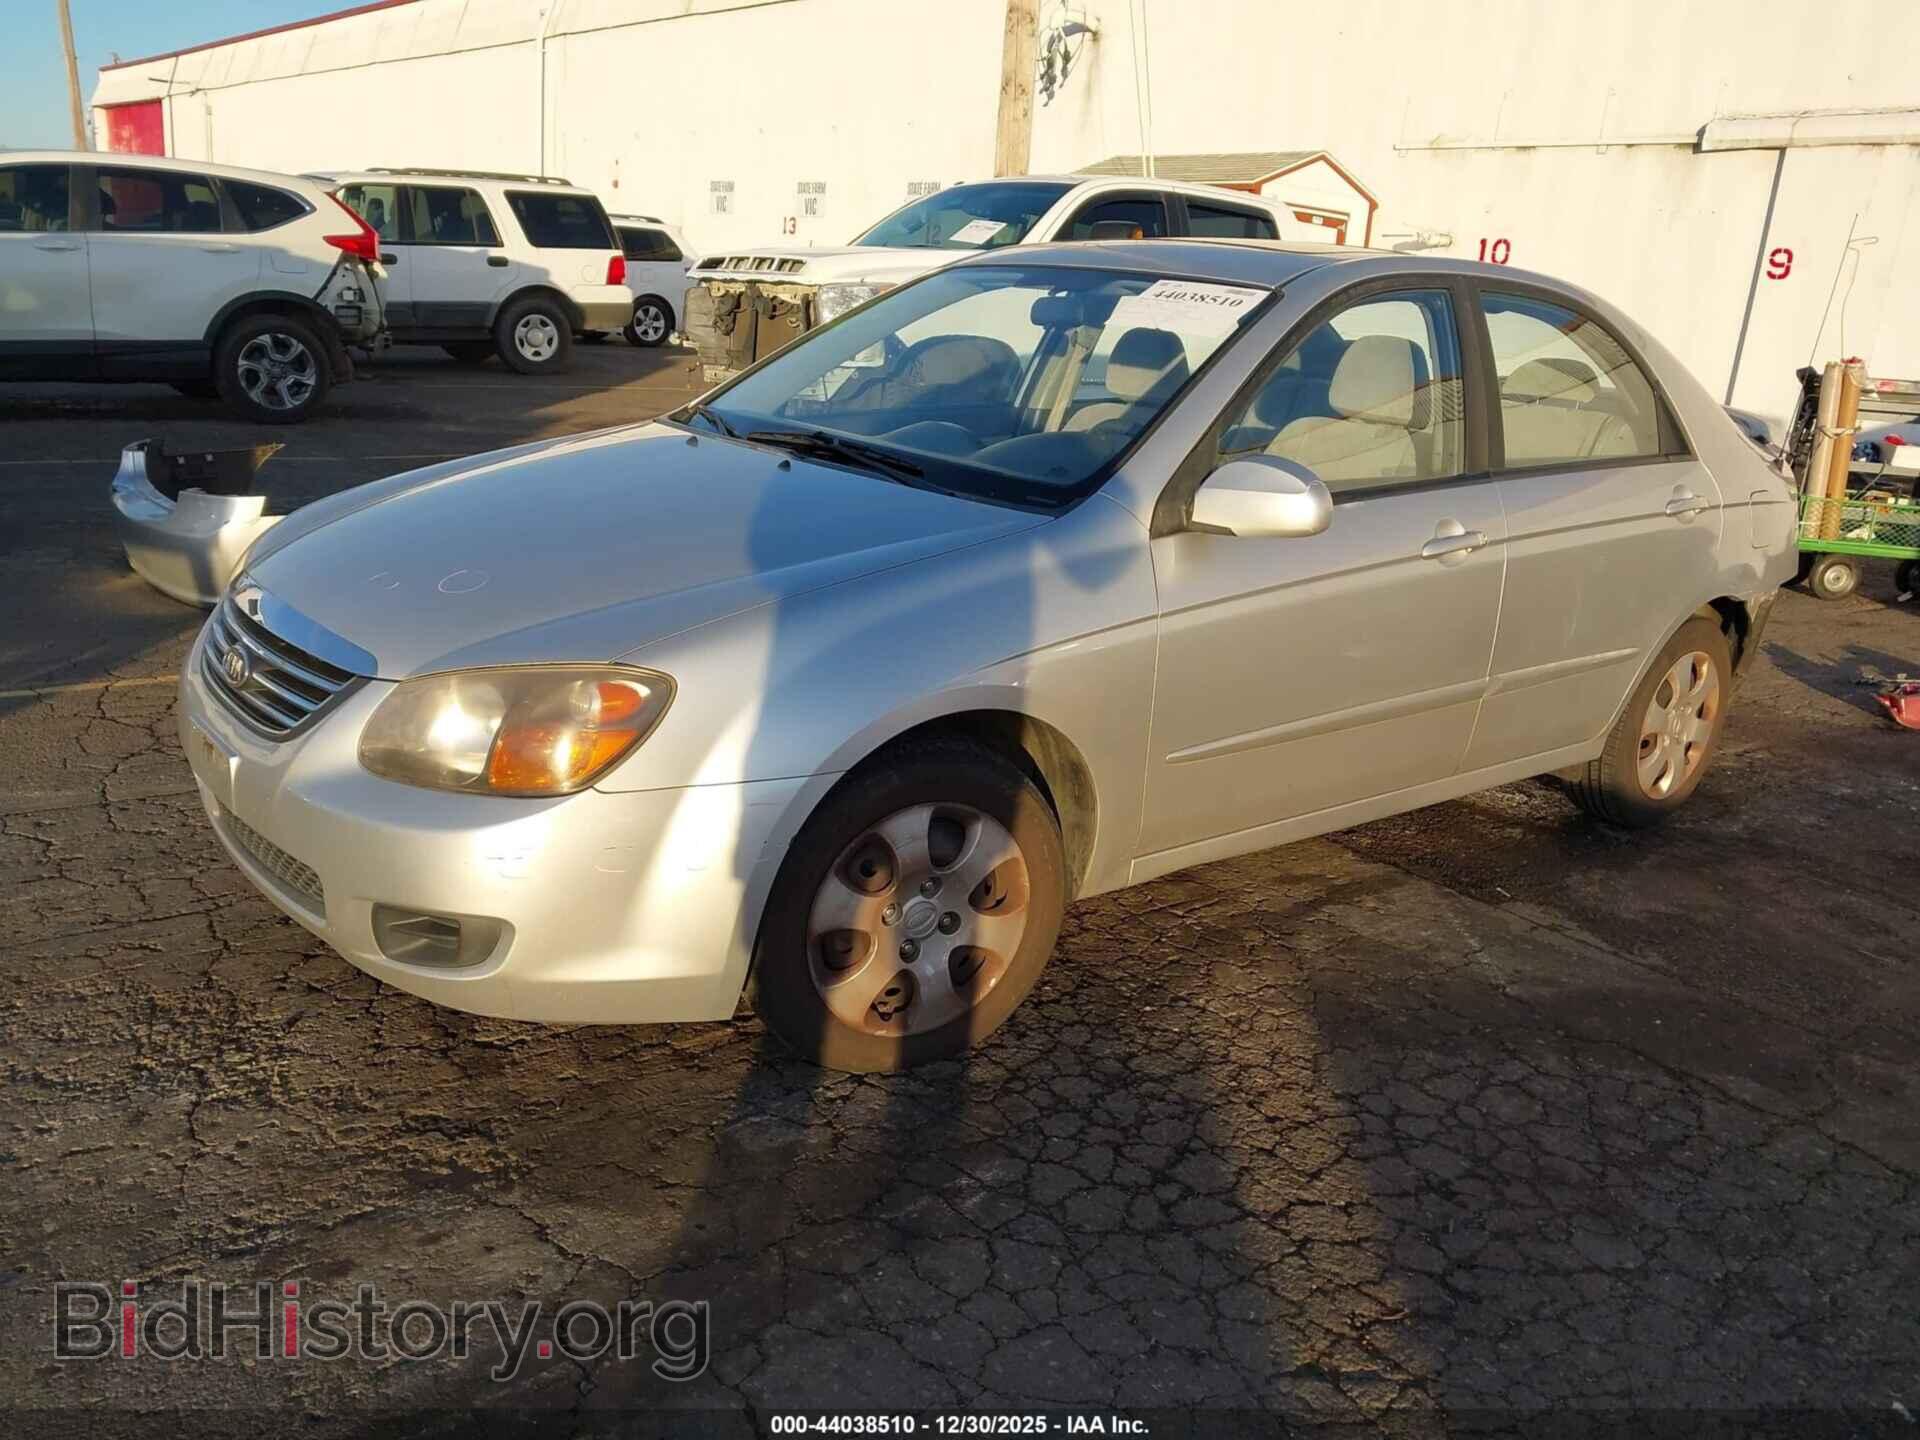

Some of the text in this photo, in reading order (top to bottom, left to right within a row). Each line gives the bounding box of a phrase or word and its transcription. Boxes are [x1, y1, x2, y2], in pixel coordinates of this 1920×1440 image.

[797, 182, 827, 194] STATE FARM
[907, 182, 922, 195] STATE
[804, 198, 817, 215] VIC
[783, 216, 797, 235] 13
[926, 225, 942, 245] 12
[1479, 238, 1511, 265] 10
[1766, 248, 1793, 280] 9
[1153, 289, 1244, 307] 44038510
